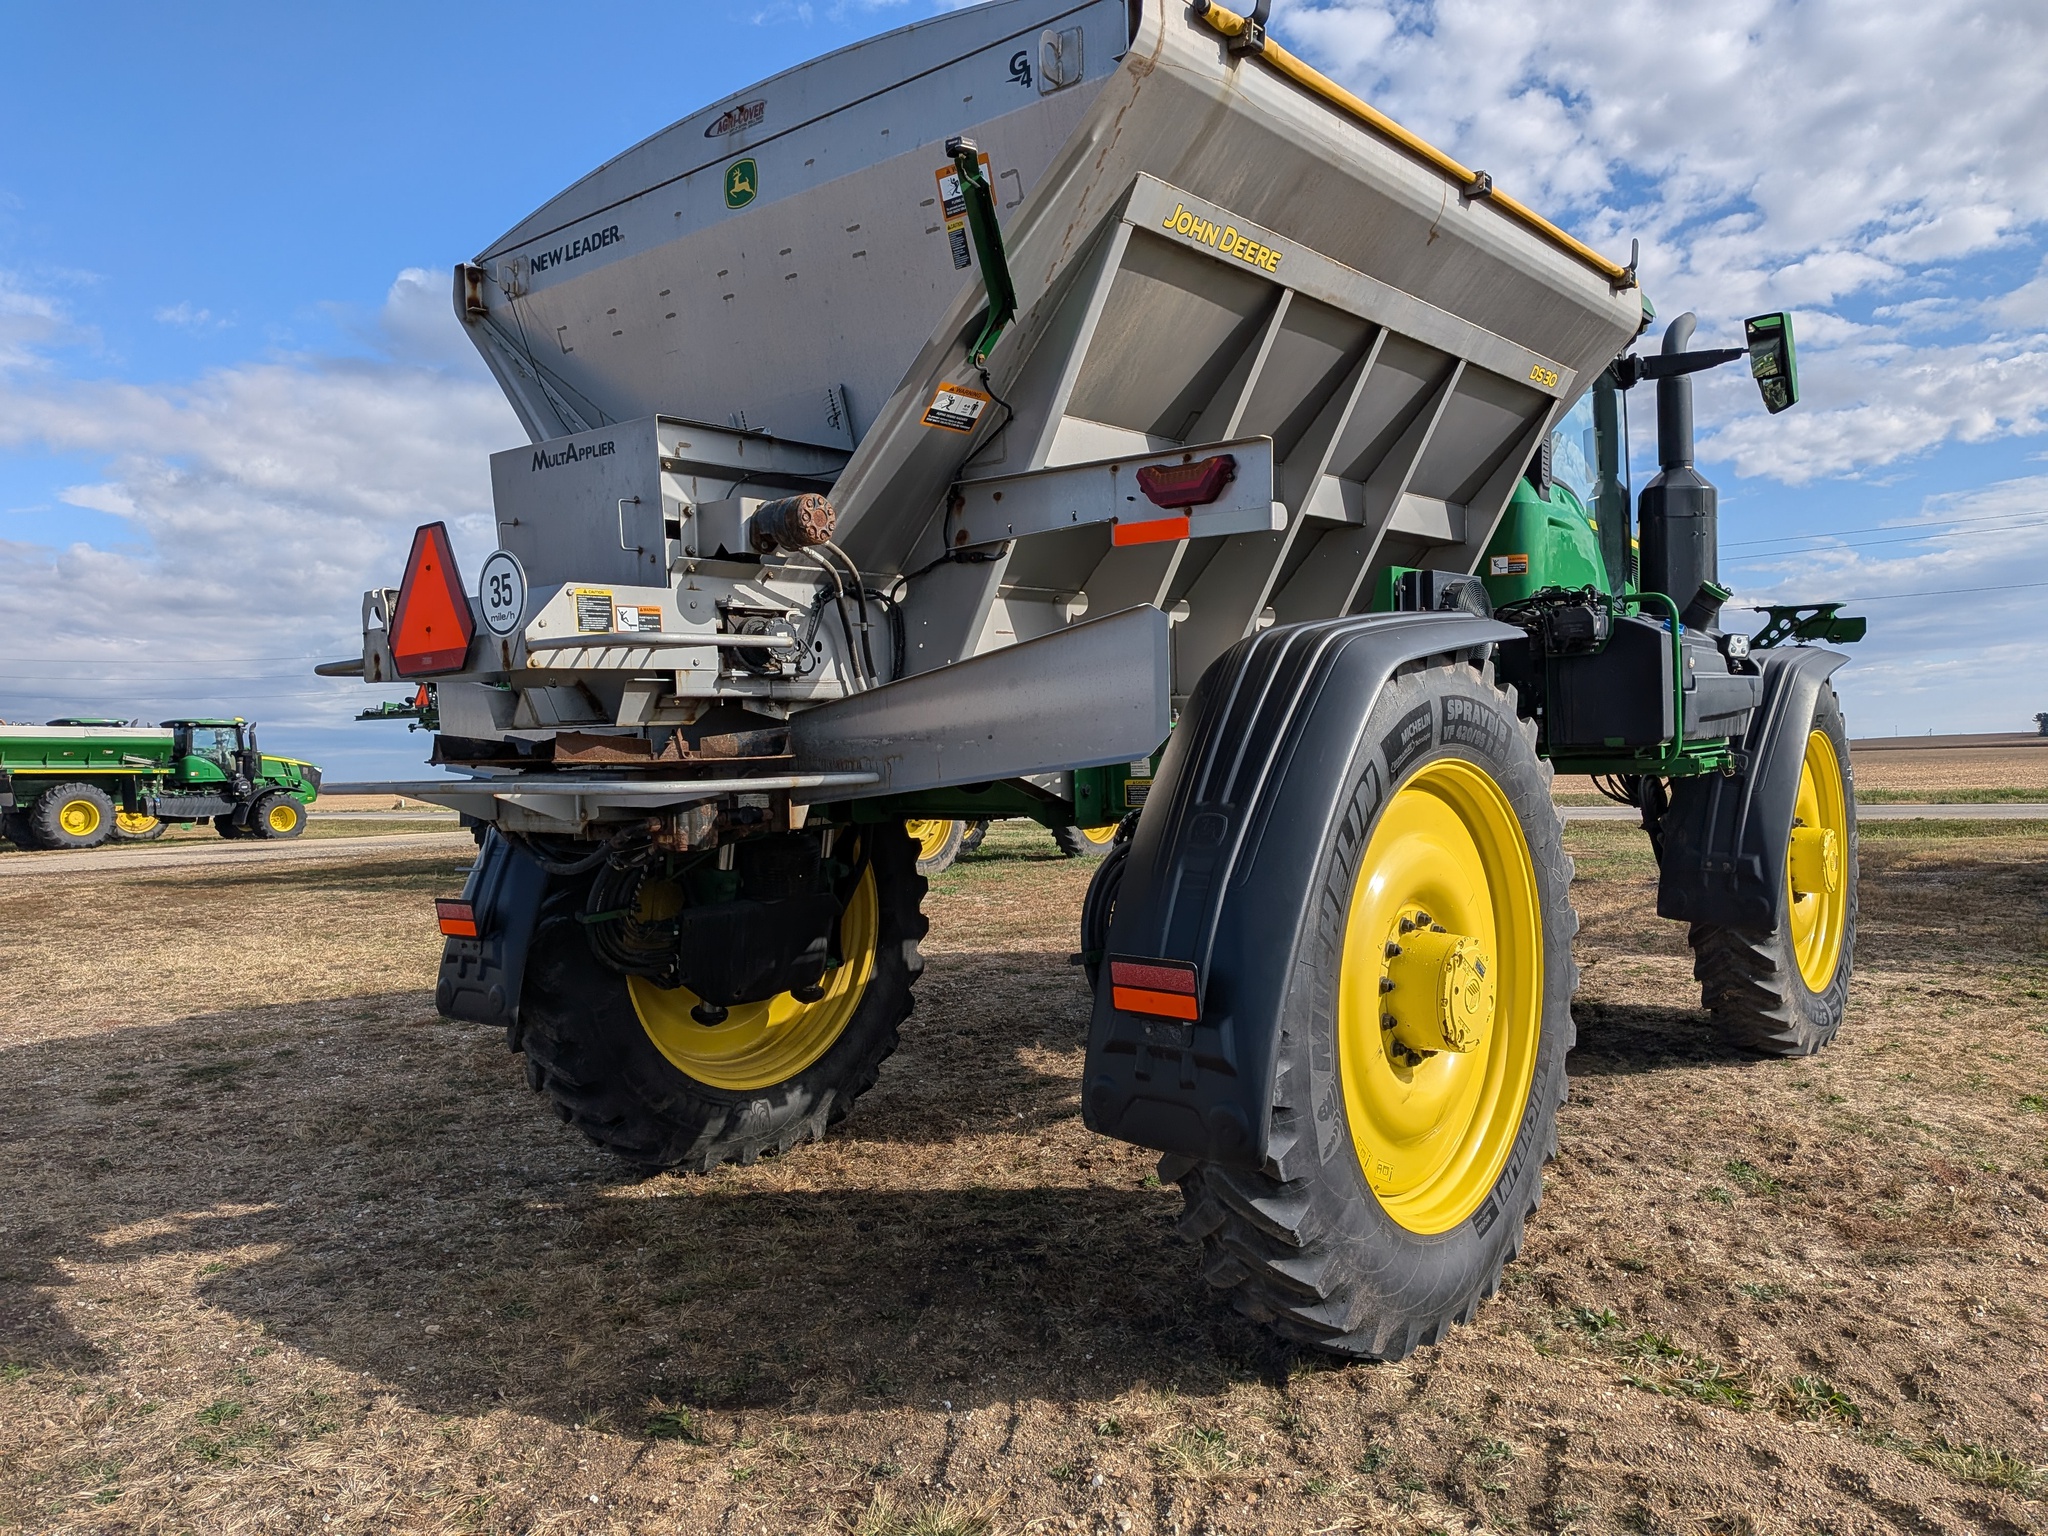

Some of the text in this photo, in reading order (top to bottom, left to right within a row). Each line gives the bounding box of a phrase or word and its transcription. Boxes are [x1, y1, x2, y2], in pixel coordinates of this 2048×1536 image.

[530, 225, 620, 275] NEW LEADER
[1162, 203, 1283, 273] JOHN DEERE
[489, 572, 513, 609] 35
[490, 611, 516, 623] mile/h
[1401, 711, 1431, 746] MICHELIN
[1311, 765, 1377, 1072] MICHELIN
[1498, 1068, 1547, 1198] MICHELIN
